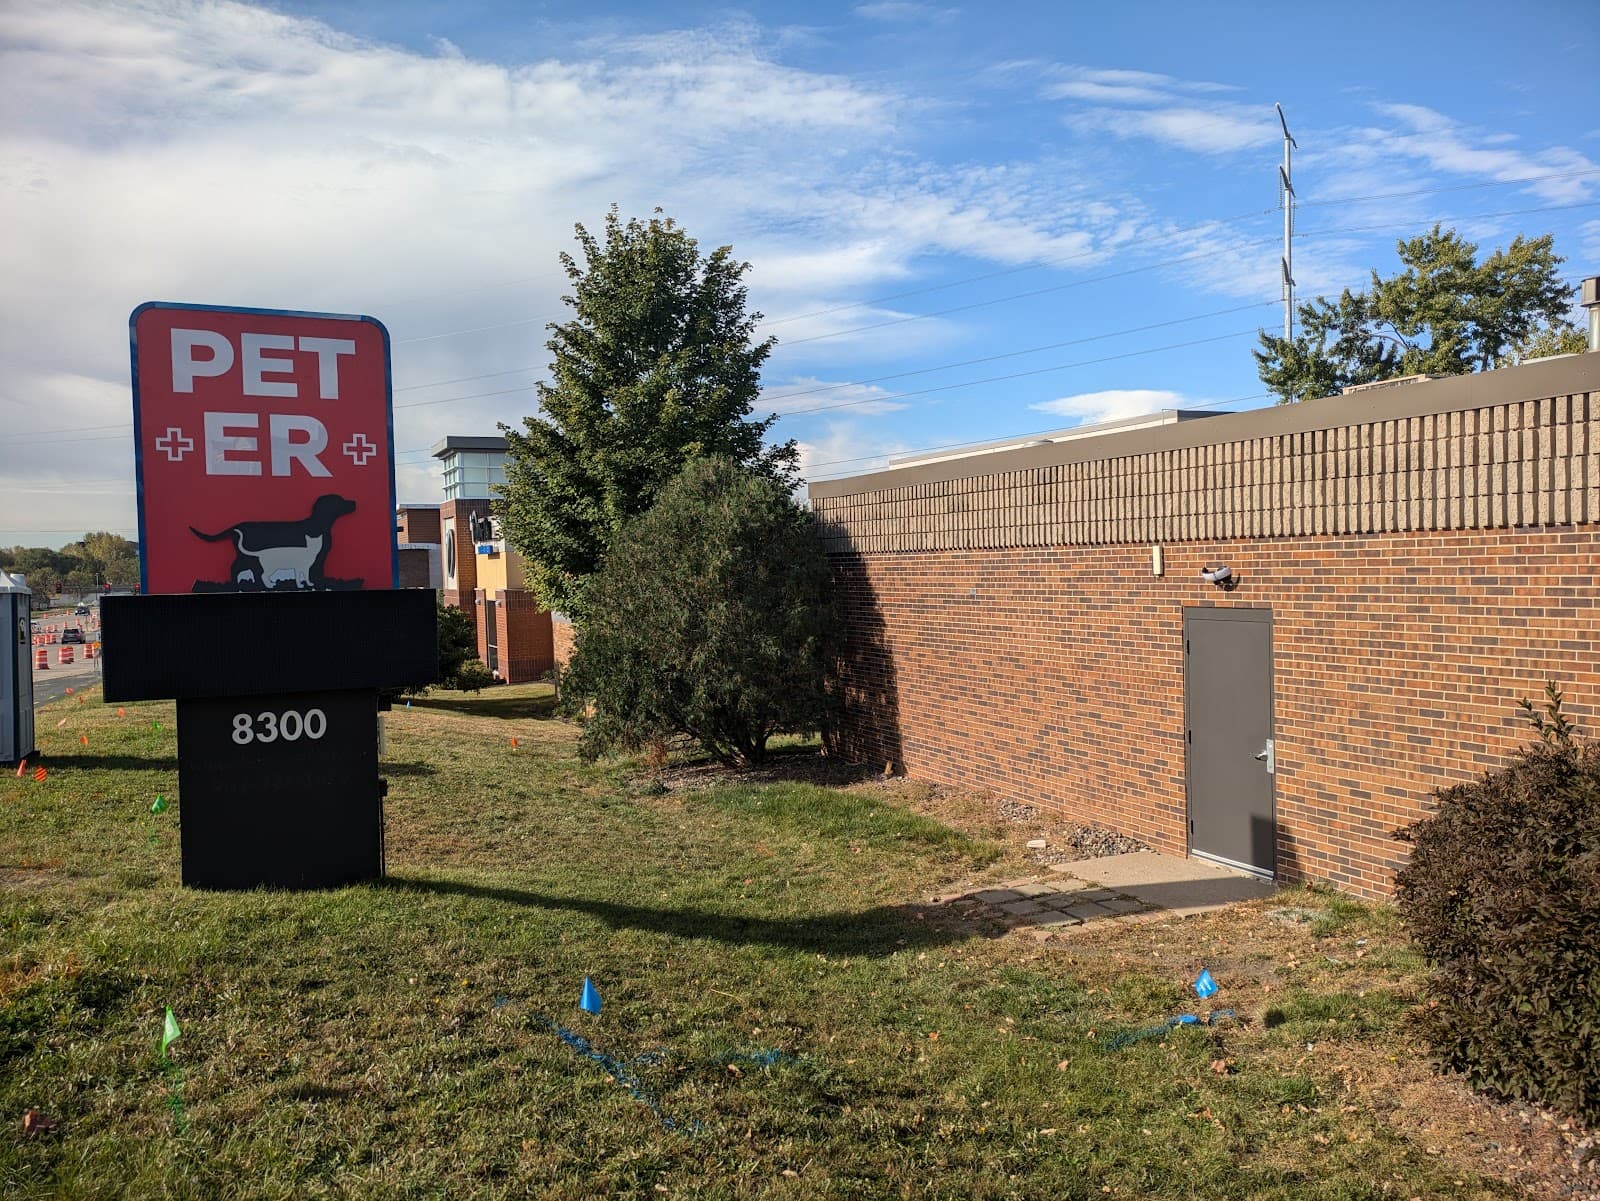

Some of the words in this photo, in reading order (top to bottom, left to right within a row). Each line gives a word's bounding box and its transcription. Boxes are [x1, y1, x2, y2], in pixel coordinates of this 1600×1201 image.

[170, 328, 356, 399] PET
[204, 412, 333, 478] ER
[231, 708, 327, 745] 8300
